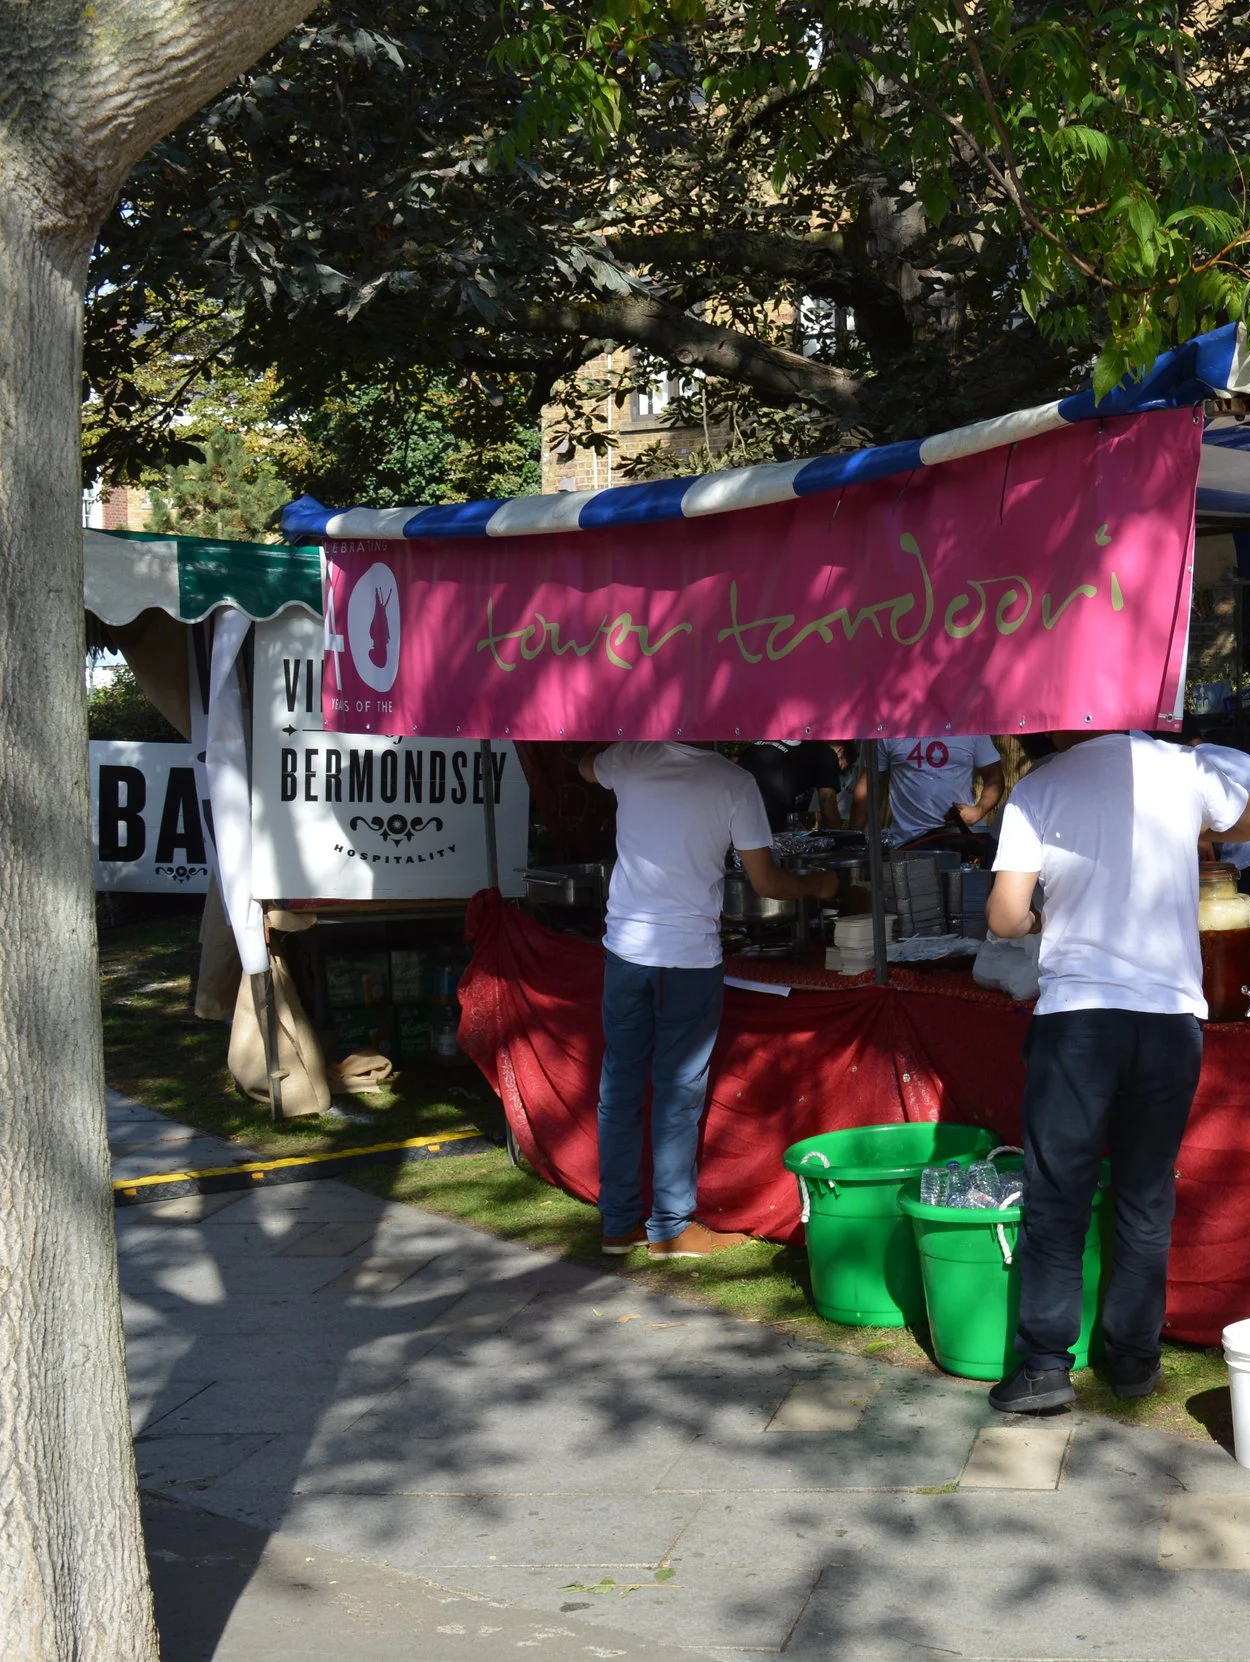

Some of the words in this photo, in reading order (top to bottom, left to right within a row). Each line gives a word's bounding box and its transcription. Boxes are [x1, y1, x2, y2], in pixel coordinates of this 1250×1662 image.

[717, 524, 1124, 664] tandoori
[283, 659, 324, 713] VI
[355, 700, 371, 712] OF
[377, 701, 393, 713] THE
[906, 740, 949, 769] 40
[281, 747, 507, 804] BERMONDSEY
[334, 844, 456, 864] HOSPITALITY
